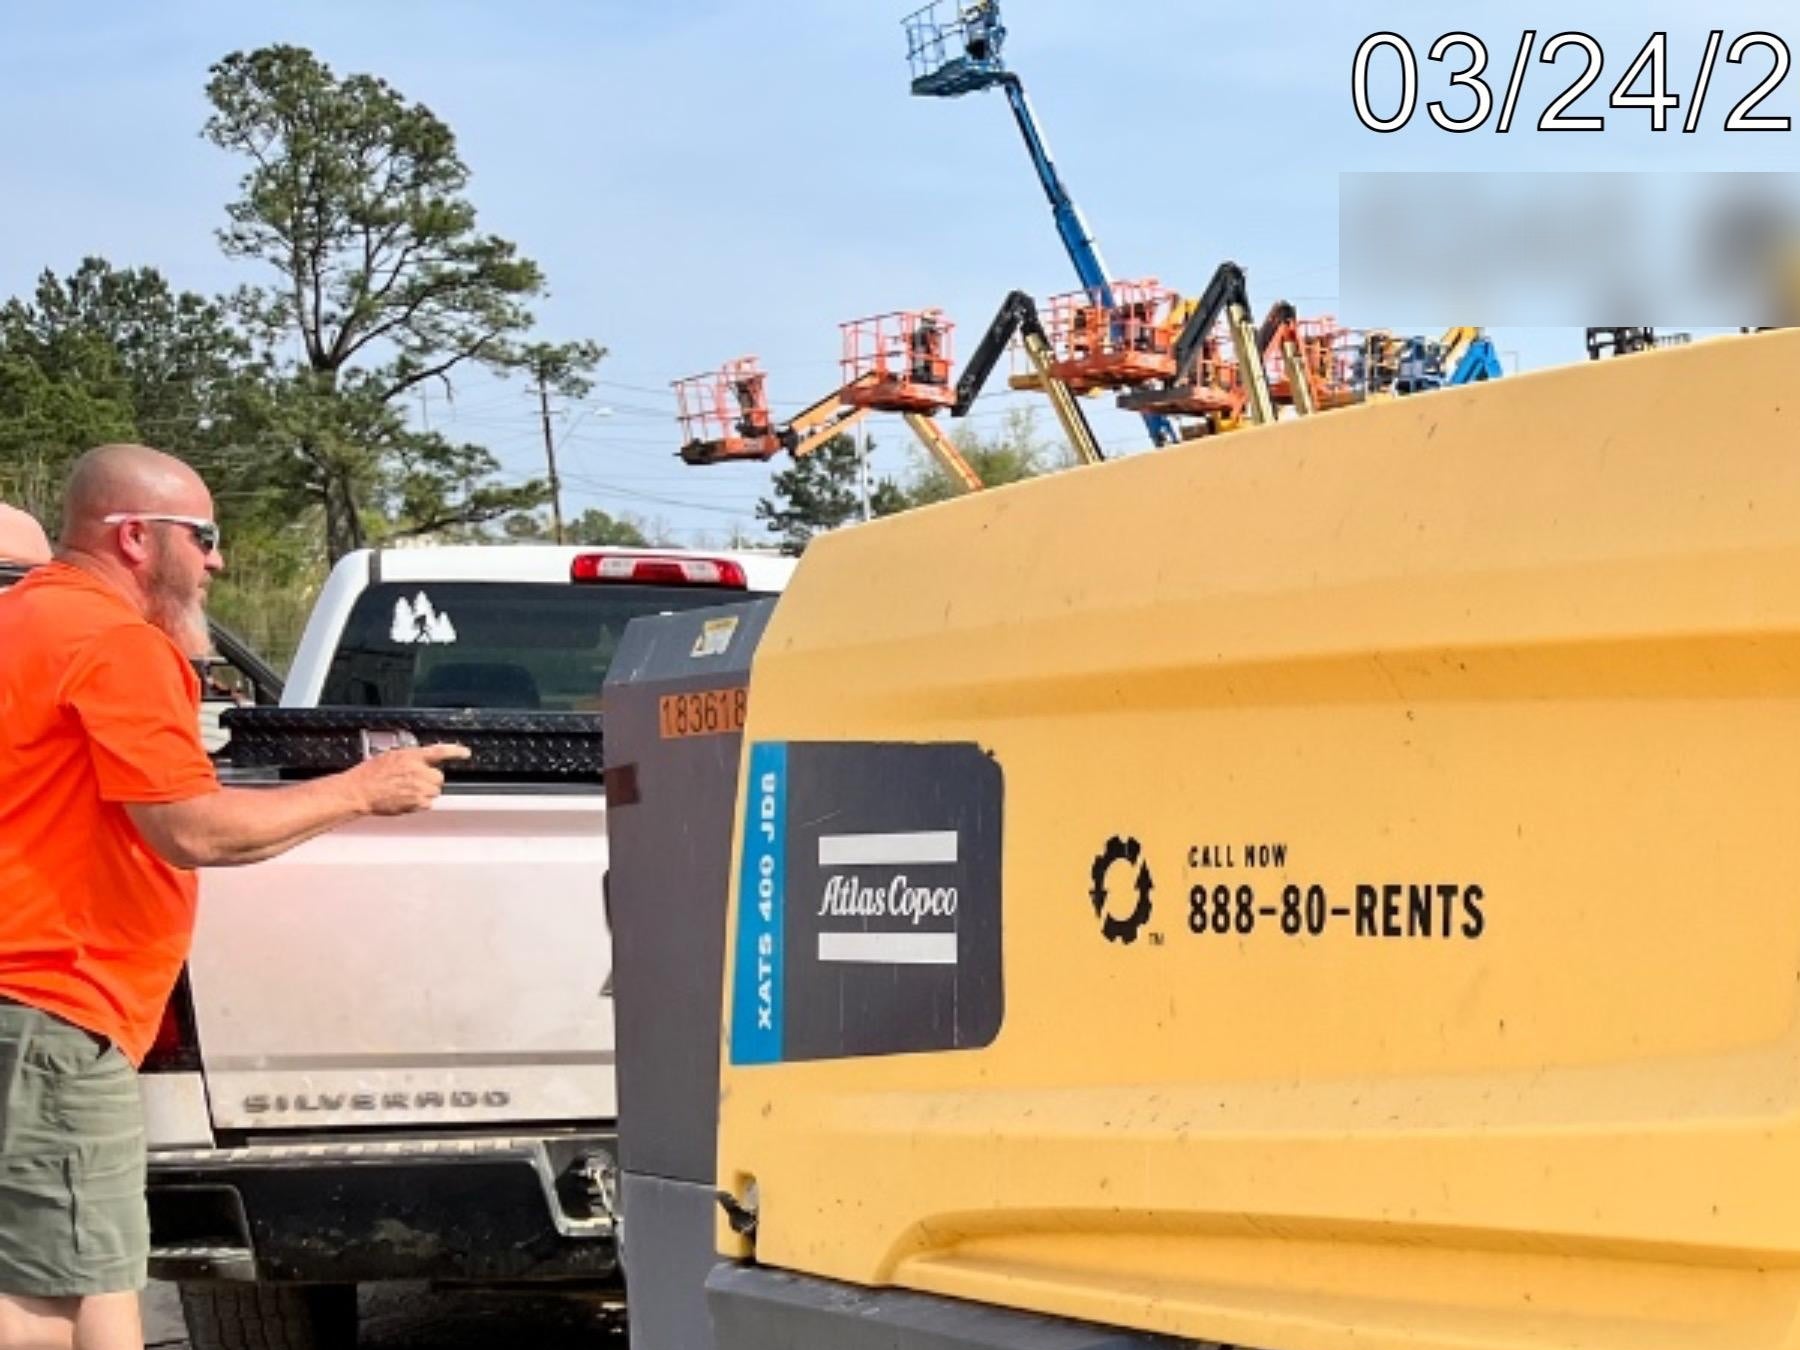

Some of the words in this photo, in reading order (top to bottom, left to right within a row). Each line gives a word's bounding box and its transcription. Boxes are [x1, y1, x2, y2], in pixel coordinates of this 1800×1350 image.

[662, 688, 747, 735] 183618
[1187, 845, 1235, 868] CALL
[1245, 844, 1288, 868] NOW
[758, 854, 775, 922] 400
[817, 874, 886, 917] Atlas
[888, 874, 959, 926] Copco
[1187, 883, 1485, 939] 888-80-RENTS
[758, 933, 773, 1030] XATS
[243, 1090, 511, 1114] SILVERADO
